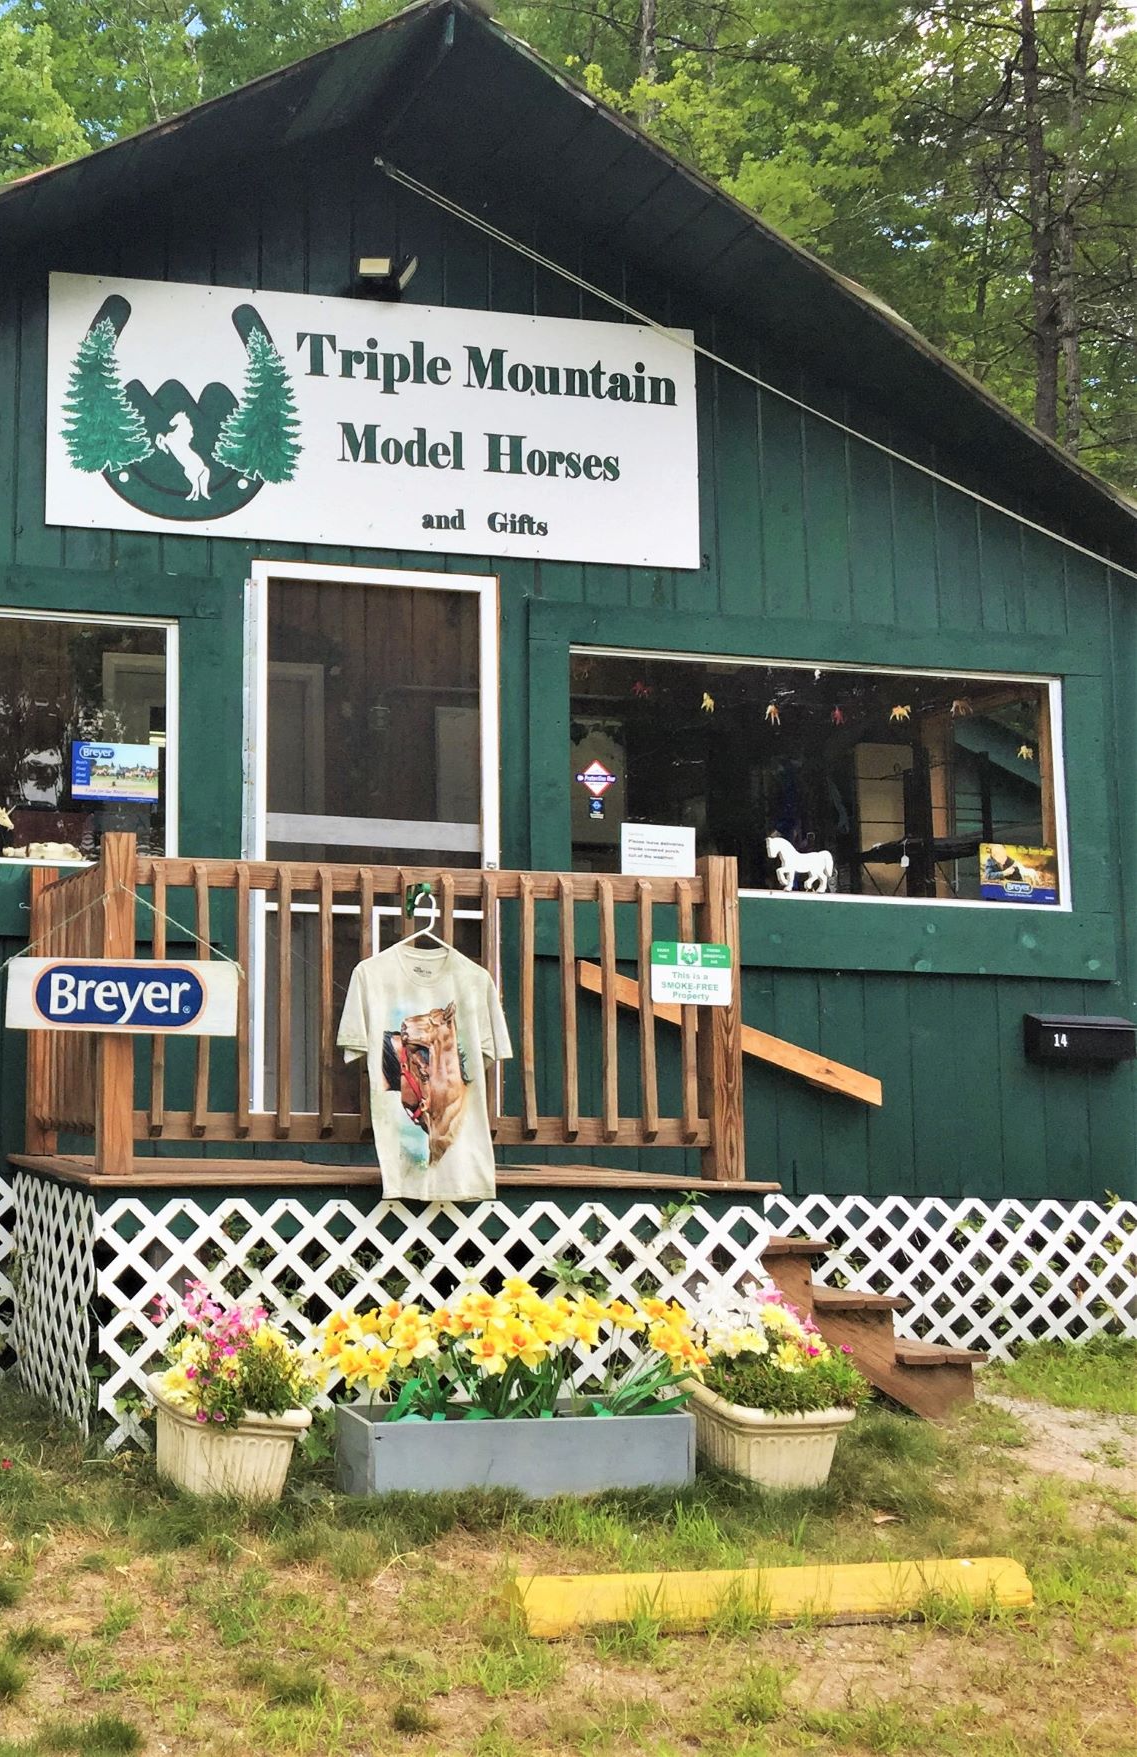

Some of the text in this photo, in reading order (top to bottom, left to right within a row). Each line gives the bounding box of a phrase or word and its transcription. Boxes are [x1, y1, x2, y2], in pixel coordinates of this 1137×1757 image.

[296, 332, 678, 407] Triple Mountain
[337, 422, 620, 482] Model Horses
[422, 509, 548, 536] and Gifts
[82, 747, 112, 759] Breyer
[1006, 882, 1031, 893] Breyer
[672, 971, 690, 979] This
[693, 972, 700, 980] is
[661, 981, 719, 992] SMOKE-FREE
[49, 972, 191, 1024] Breyer
[672, 991, 710, 1002] Property
[1053, 1033, 1068, 1048] 14
